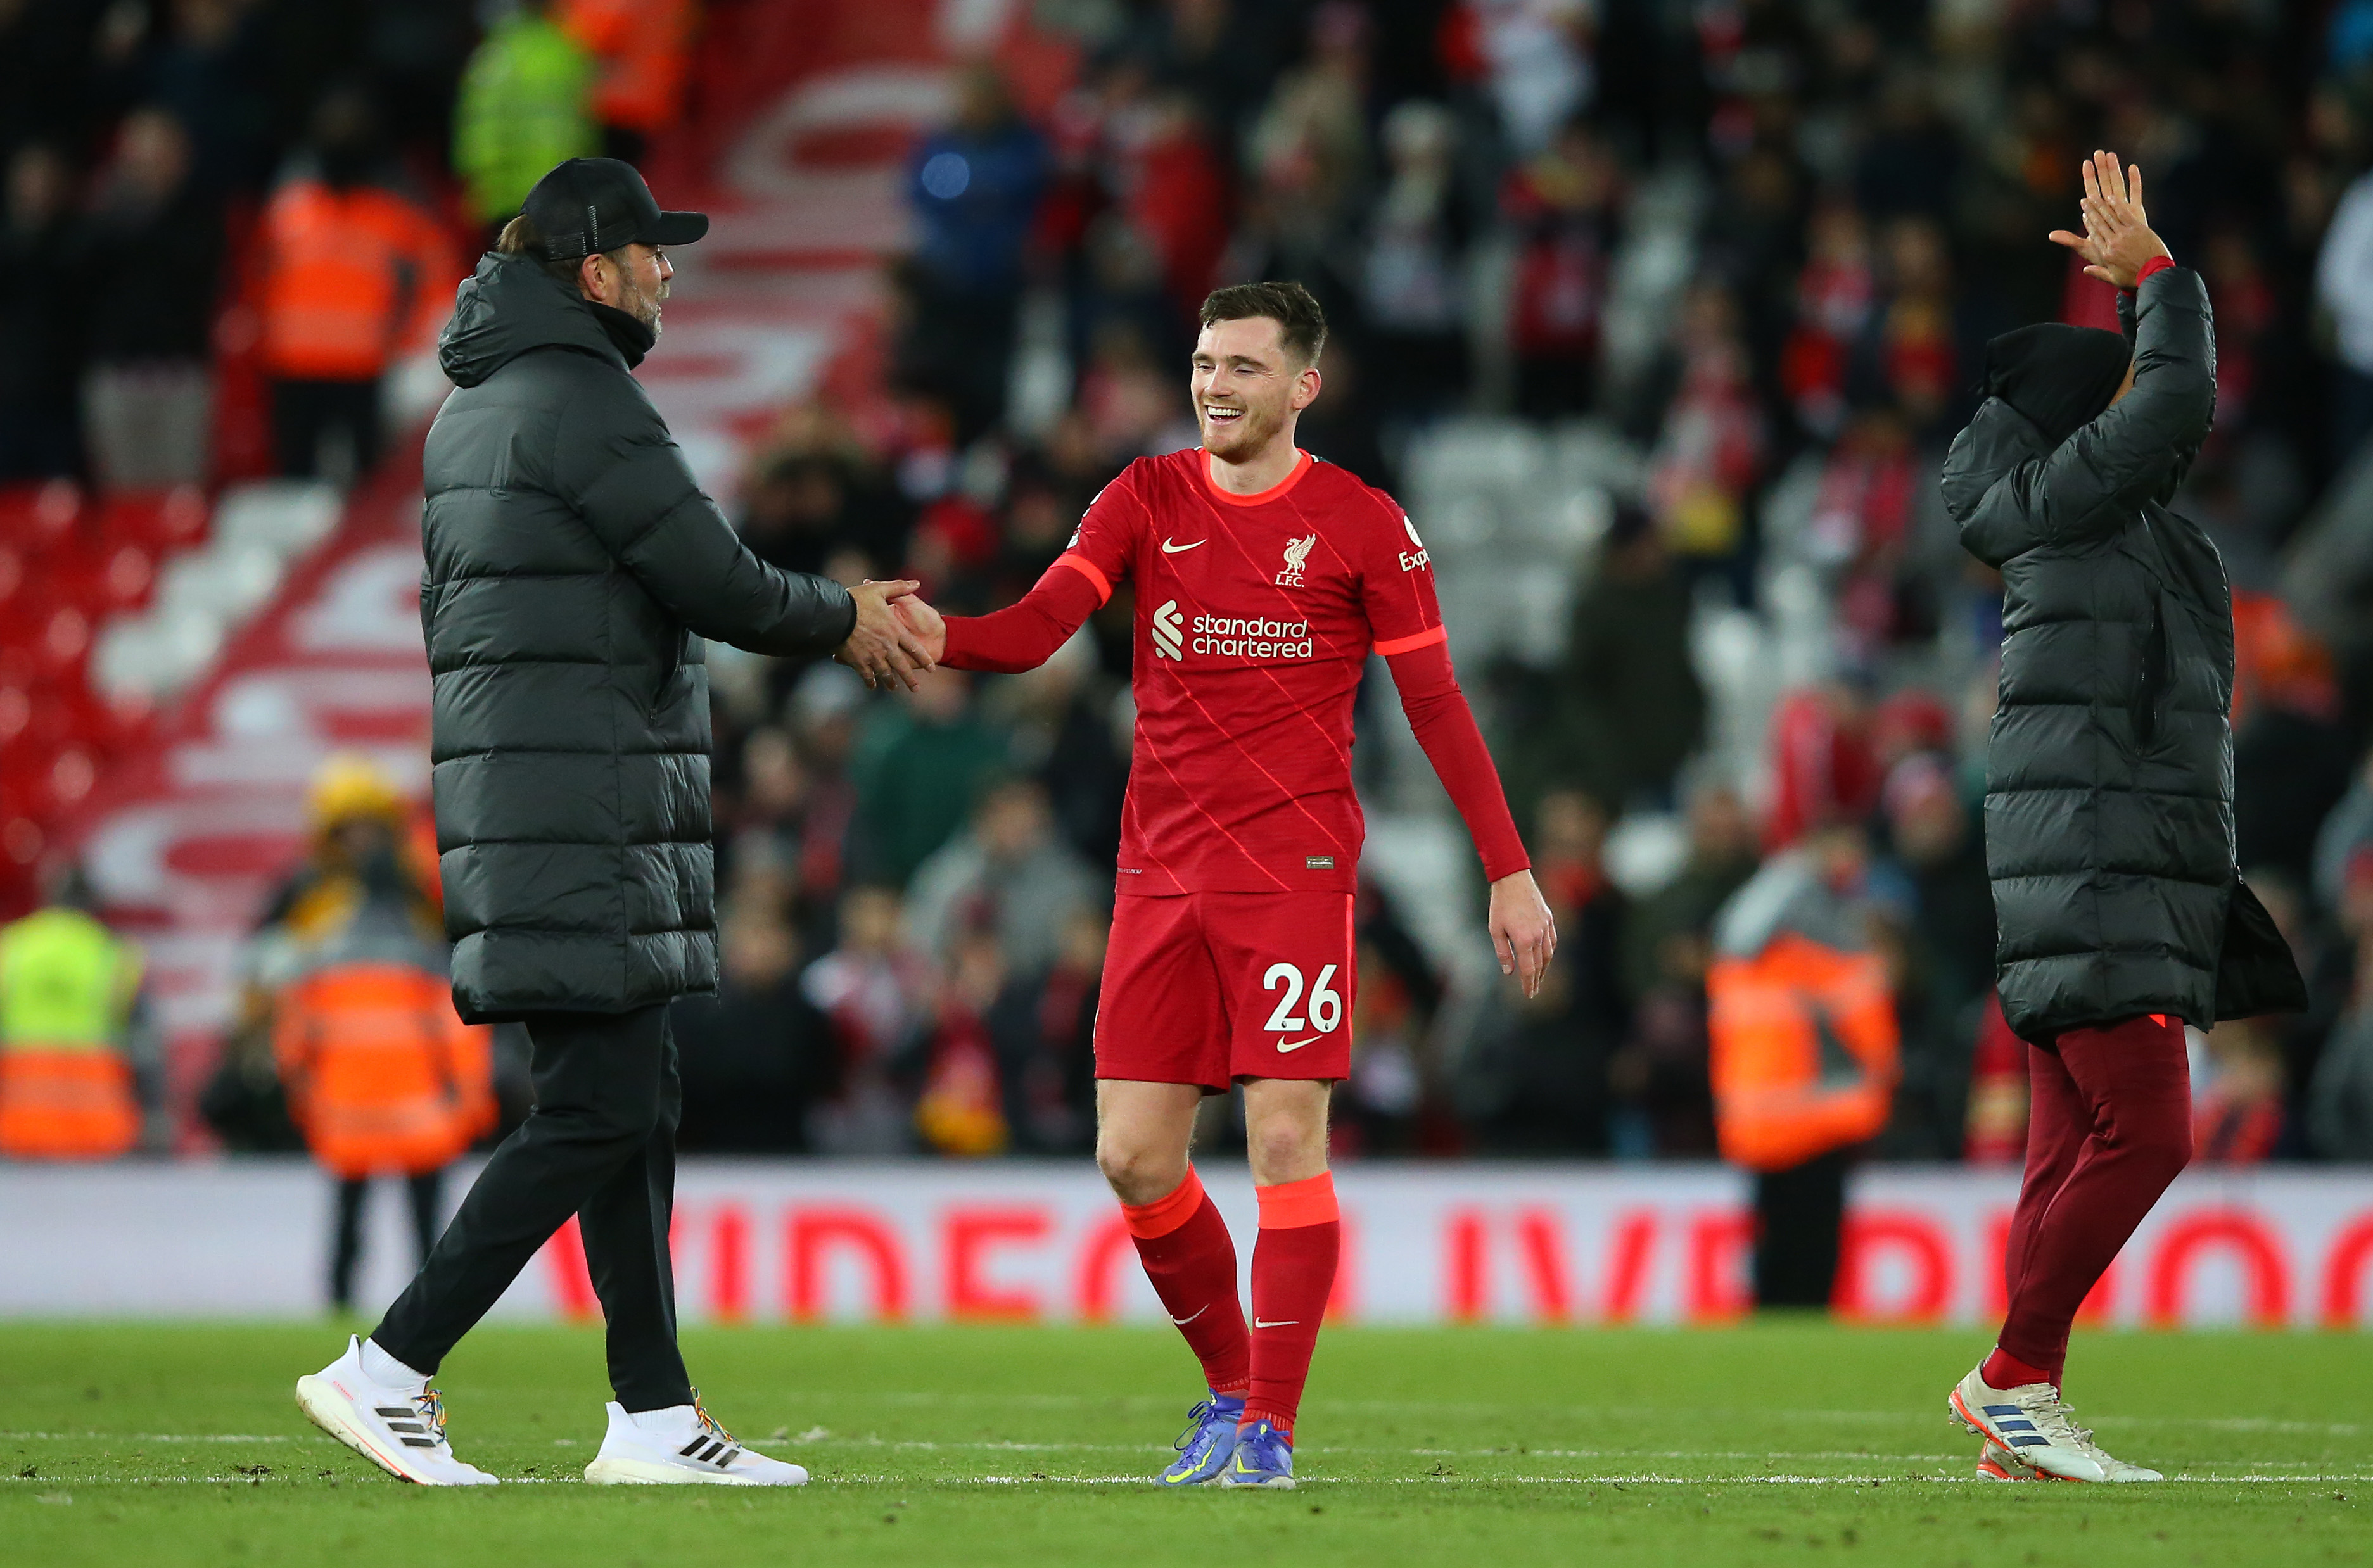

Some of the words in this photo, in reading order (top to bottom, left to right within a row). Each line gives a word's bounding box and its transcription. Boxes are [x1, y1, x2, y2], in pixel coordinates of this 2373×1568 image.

[1398, 549, 1430, 572] Exp
[1275, 574, 1304, 588] L.F.C.
[1193, 613, 1307, 638] standard
[1192, 635, 1313, 658] chartered
[1263, 962, 1342, 1032] 26
